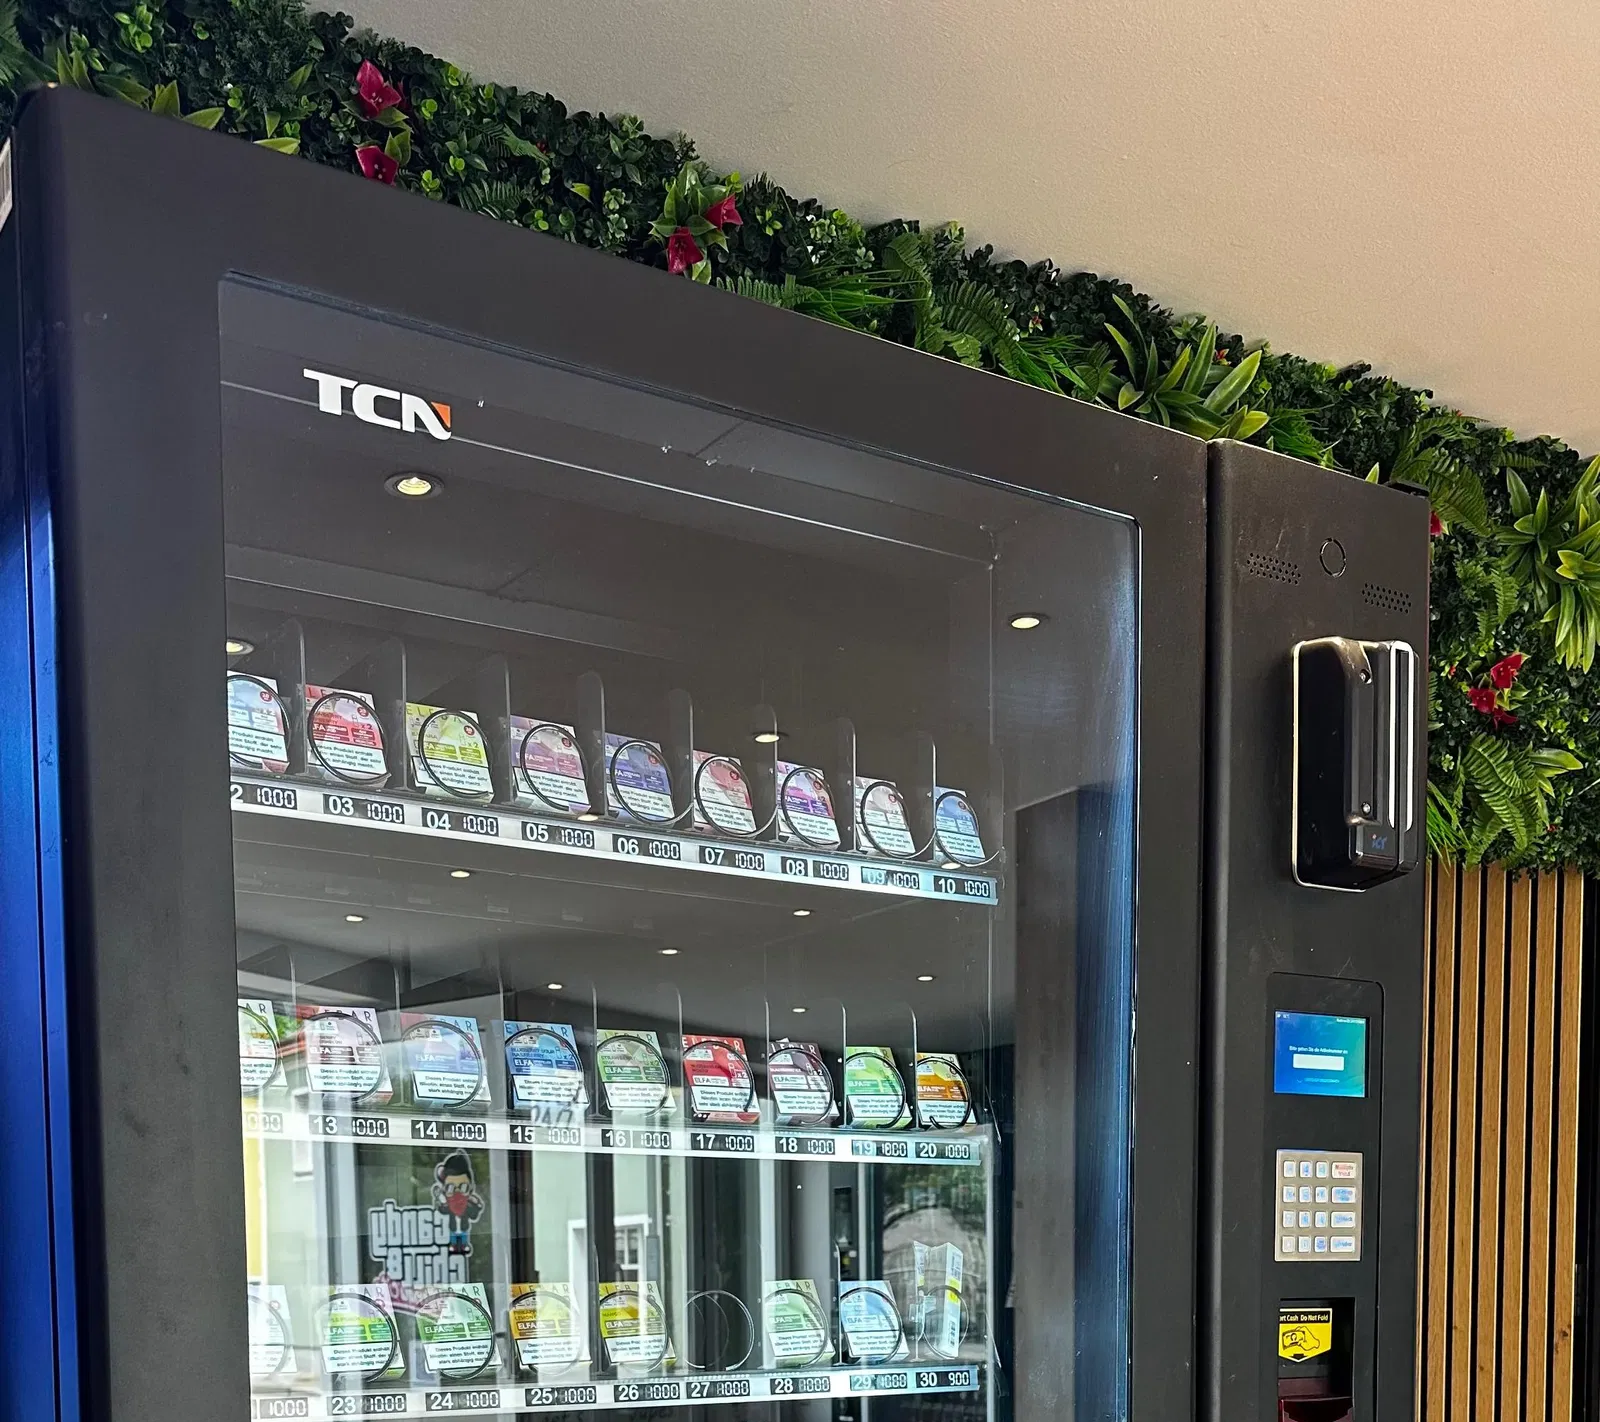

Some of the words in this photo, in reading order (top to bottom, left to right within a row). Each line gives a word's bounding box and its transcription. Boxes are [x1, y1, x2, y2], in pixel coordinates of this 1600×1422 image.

[304, 368, 451, 440] TCN
[329, 796, 354, 816] 03
[427, 812, 450, 830] 04
[526, 824, 548, 842] 05
[618, 838, 639, 855] 06
[705, 848, 724, 865] 07
[786, 859, 805, 876] 08
[868, 869, 886, 884] 09
[938, 878, 956, 893] 10
[314, 1116, 338, 1134] 13
[415, 1121, 438, 1138] 14
[513, 1126, 535, 1142] 15
[605, 1131, 626, 1146] 16
[696, 1135, 715, 1150] 17
[779, 1138, 798, 1152] 18
[855, 1142, 872, 1155] 19
[920, 1143, 937, 1157] 20
[775, 1378, 793, 1393] 28
[854, 1376, 871, 1389] 29
[920, 1373, 937, 1386] 30
[531, 1389, 552, 1405] 25
[619, 1385, 639, 1400] 26
[691, 1382, 710, 1397] 27
[332, 1397, 356, 1414] 23
[431, 1394, 453, 1409] 24
